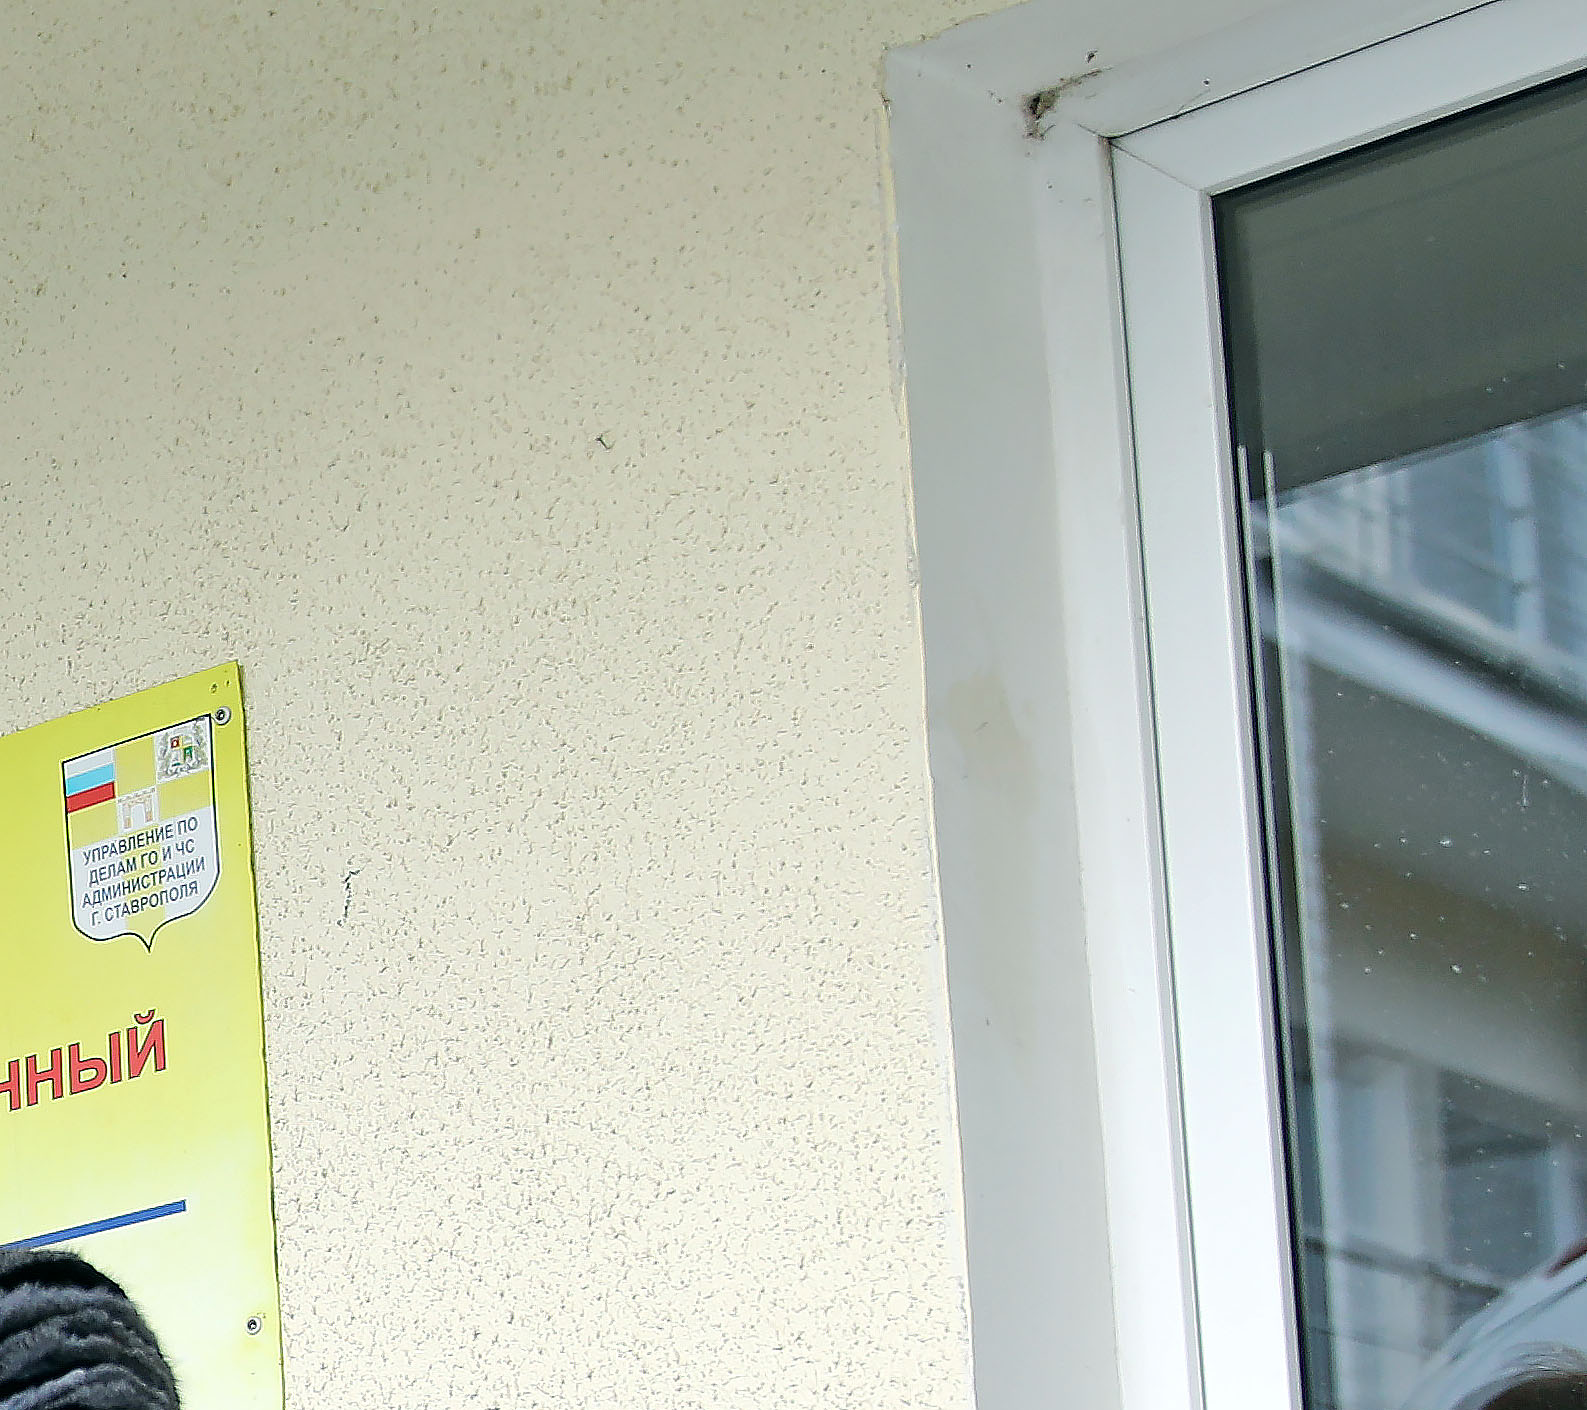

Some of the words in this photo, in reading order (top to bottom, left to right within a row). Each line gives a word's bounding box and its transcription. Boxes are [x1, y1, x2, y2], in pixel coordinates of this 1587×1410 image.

[82, 824, 174, 866] УПРАВЛЕНИЕ
[177, 816, 198, 835] ПО
[89, 858, 137, 887] ДЕЛАМ
[140, 850, 158, 868] ГО
[162, 846, 172, 862] И
[176, 839, 196, 856] ЧС
[82, 856, 206, 908] АДМИНИСТРАЦИИ
[91, 911, 102, 926] Г.
[104, 881, 199, 922] СТАВРОПОЛЯ
